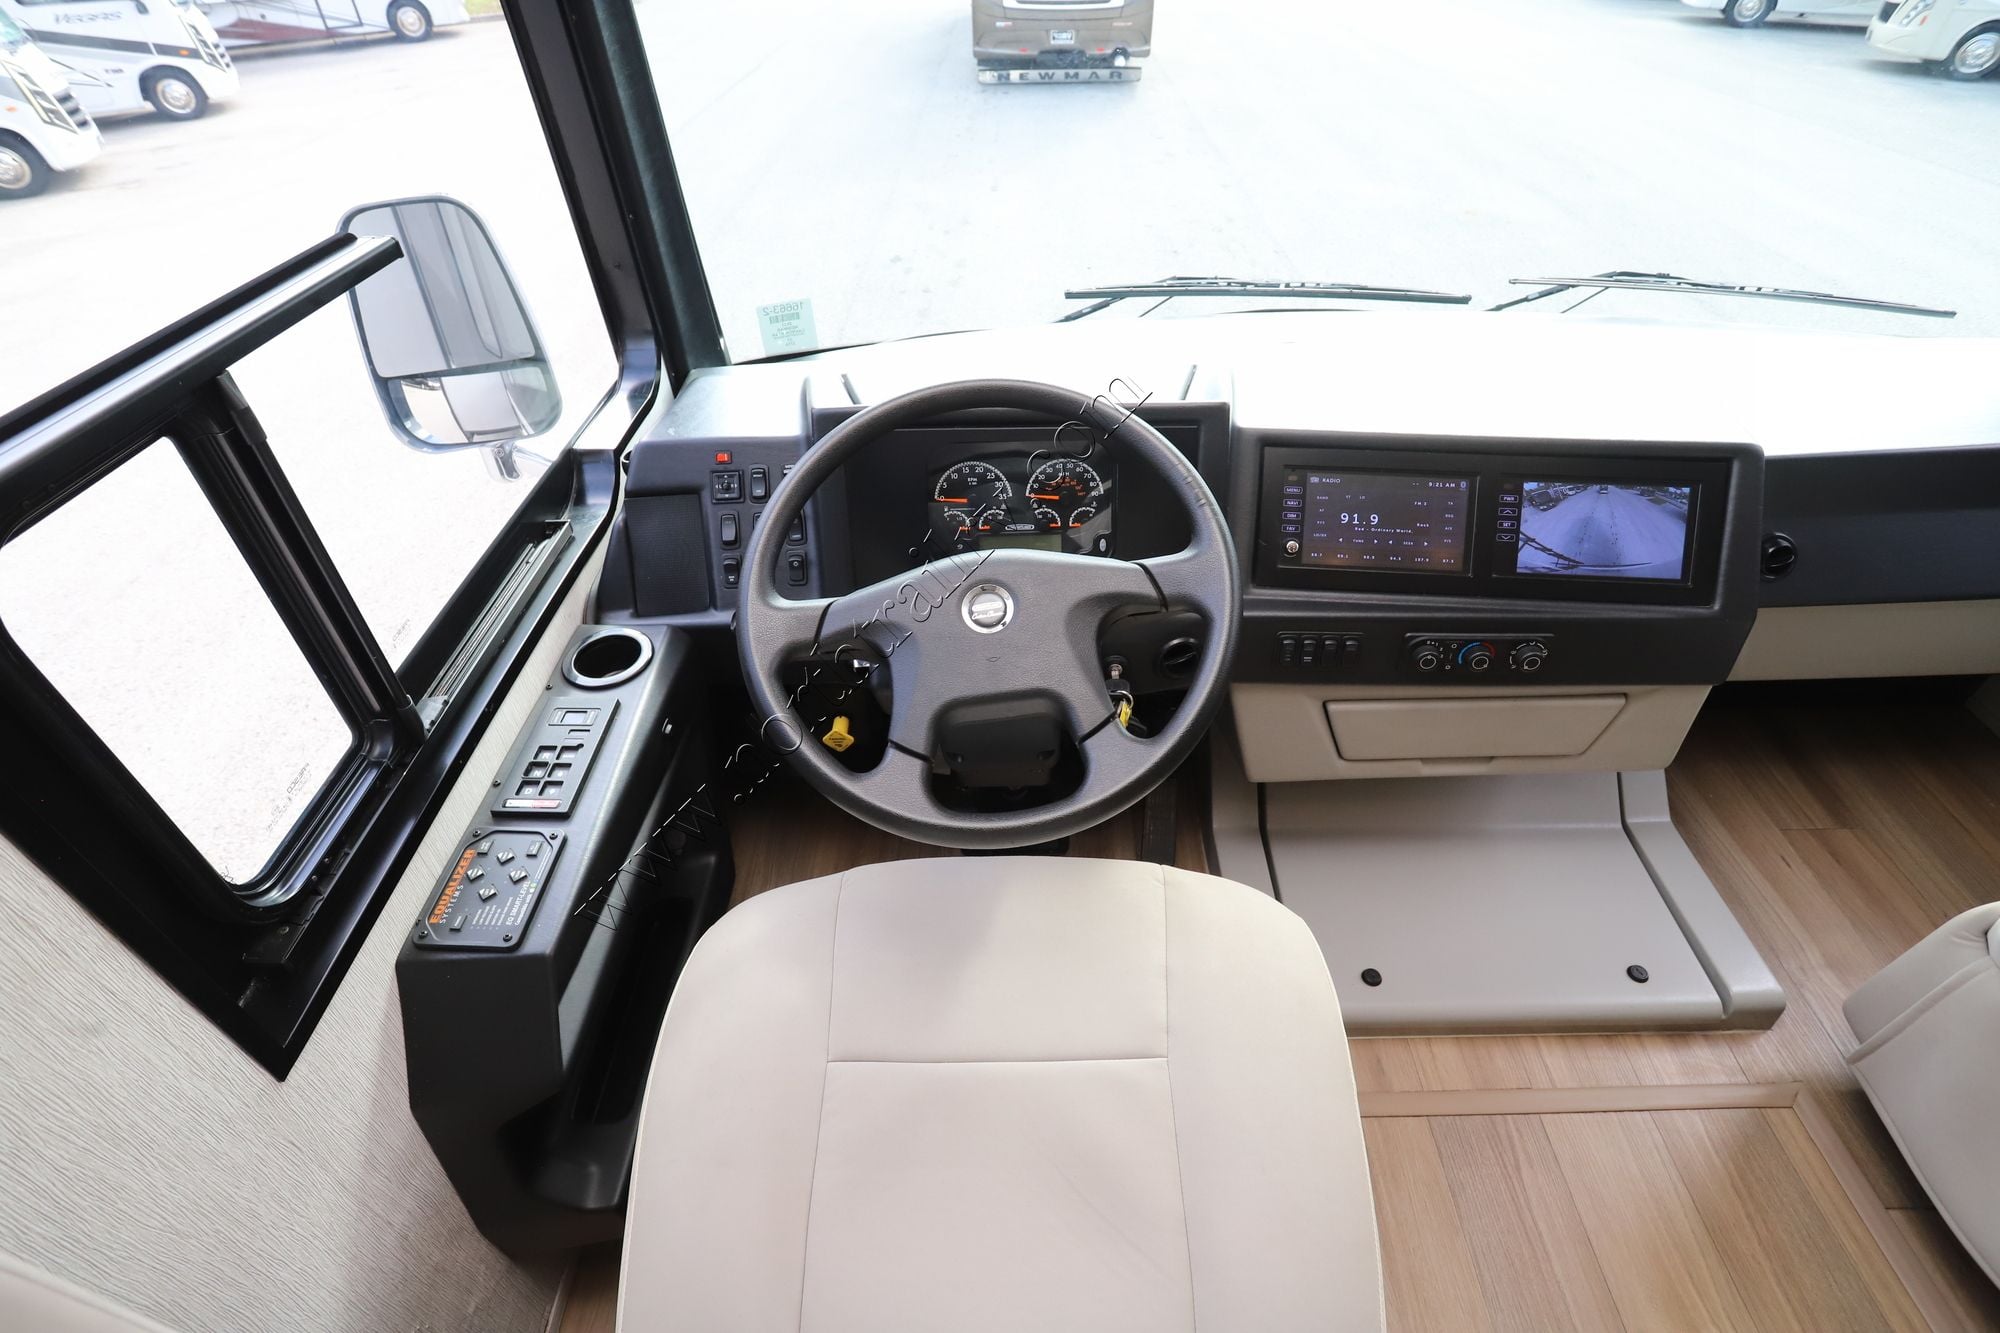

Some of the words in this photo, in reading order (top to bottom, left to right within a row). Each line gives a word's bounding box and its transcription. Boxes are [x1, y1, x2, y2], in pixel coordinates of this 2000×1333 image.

[997, 71, 1124, 81] NEWMAR
[1340, 513, 1378, 525] 91.9
[428, 849, 476, 924] EQUALIZER
[440, 885, 464, 924] SYSTEMS
